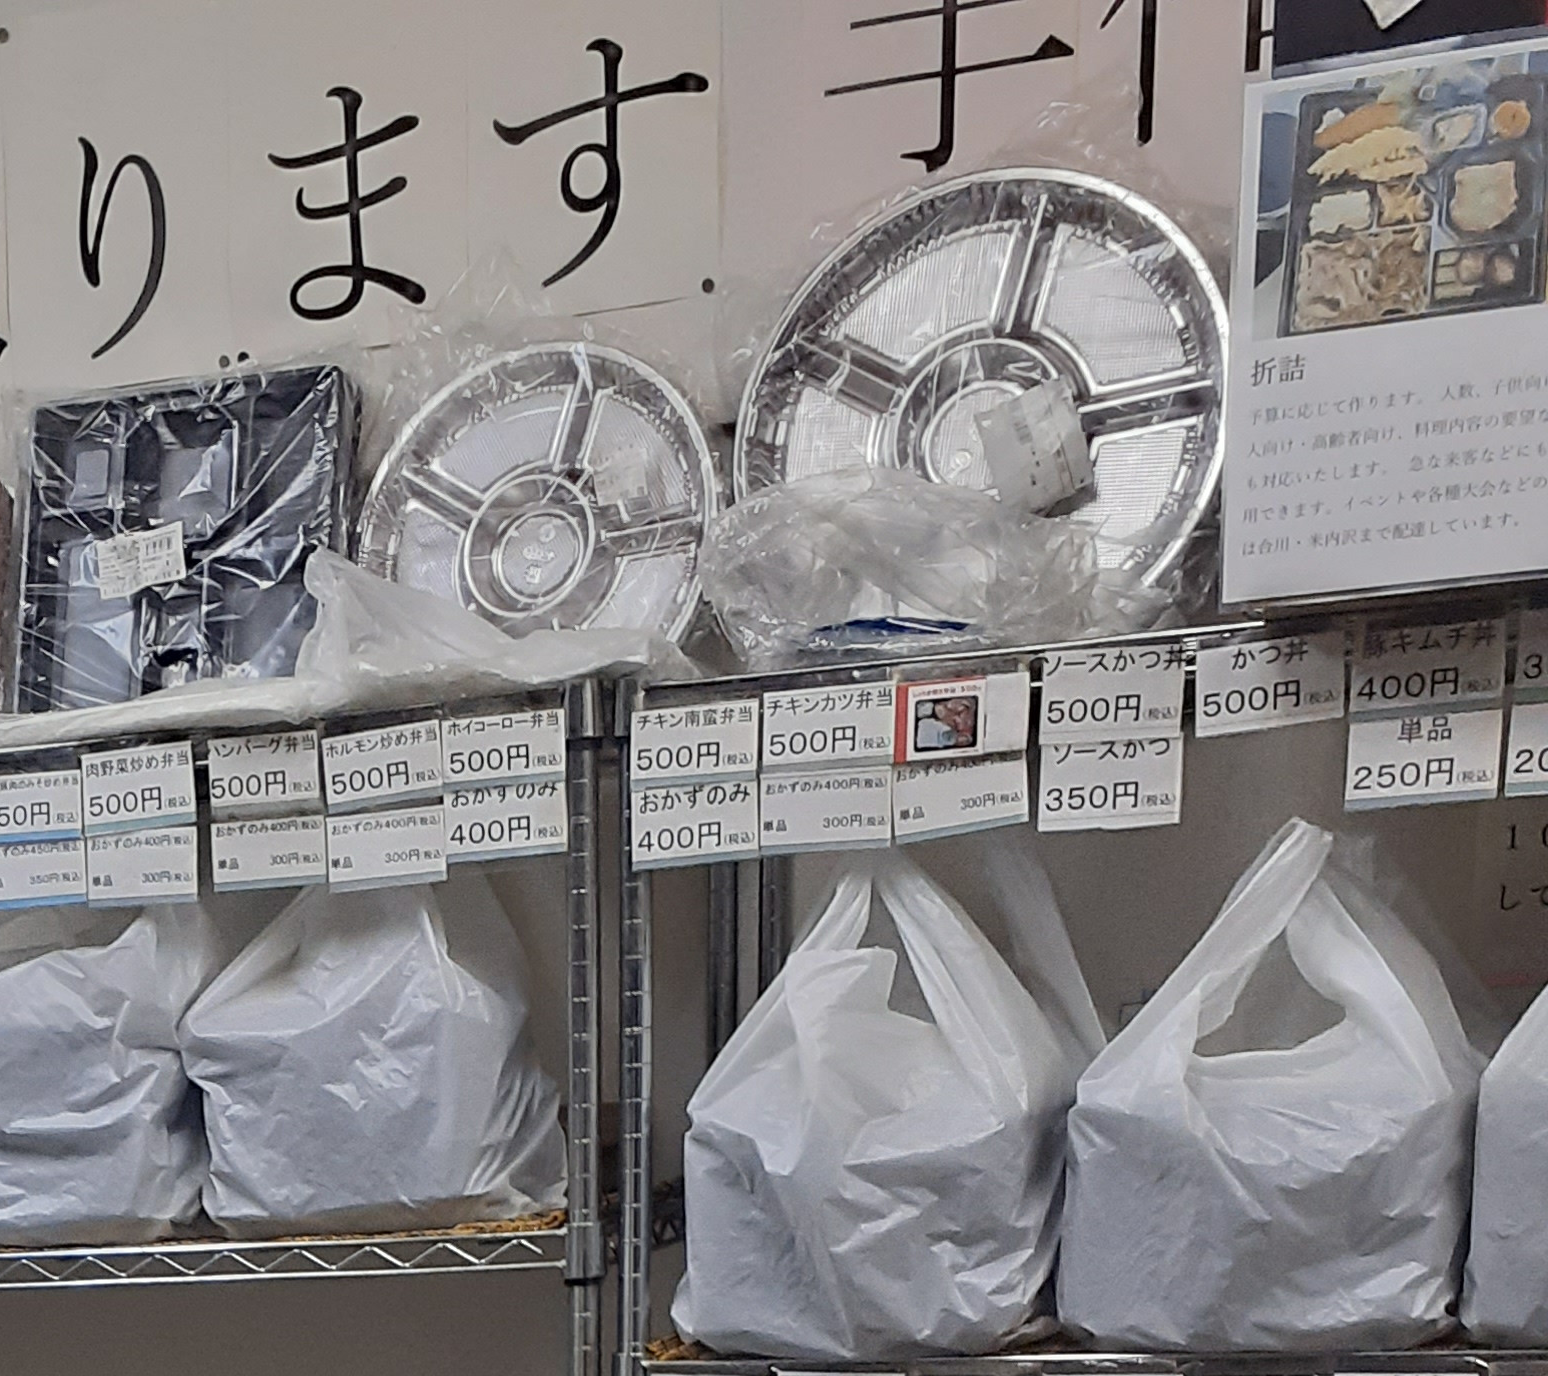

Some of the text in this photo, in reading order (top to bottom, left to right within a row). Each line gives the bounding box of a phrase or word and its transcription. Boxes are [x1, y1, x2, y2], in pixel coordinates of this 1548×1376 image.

[1251, 354, 1306, 387] 折詰
[1044, 646, 1186, 677] ソースかつ丼
[1231, 638, 1310, 671] かつ丼
[766, 686, 893, 718] チキンカツ弁当
[445, 712, 560, 737] ホイコーロー弁当
[1397, 716, 1453, 743] 単品
[1052, 738, 1172, 766] ソースかつ
[639, 783, 751, 814] おかずのみ
